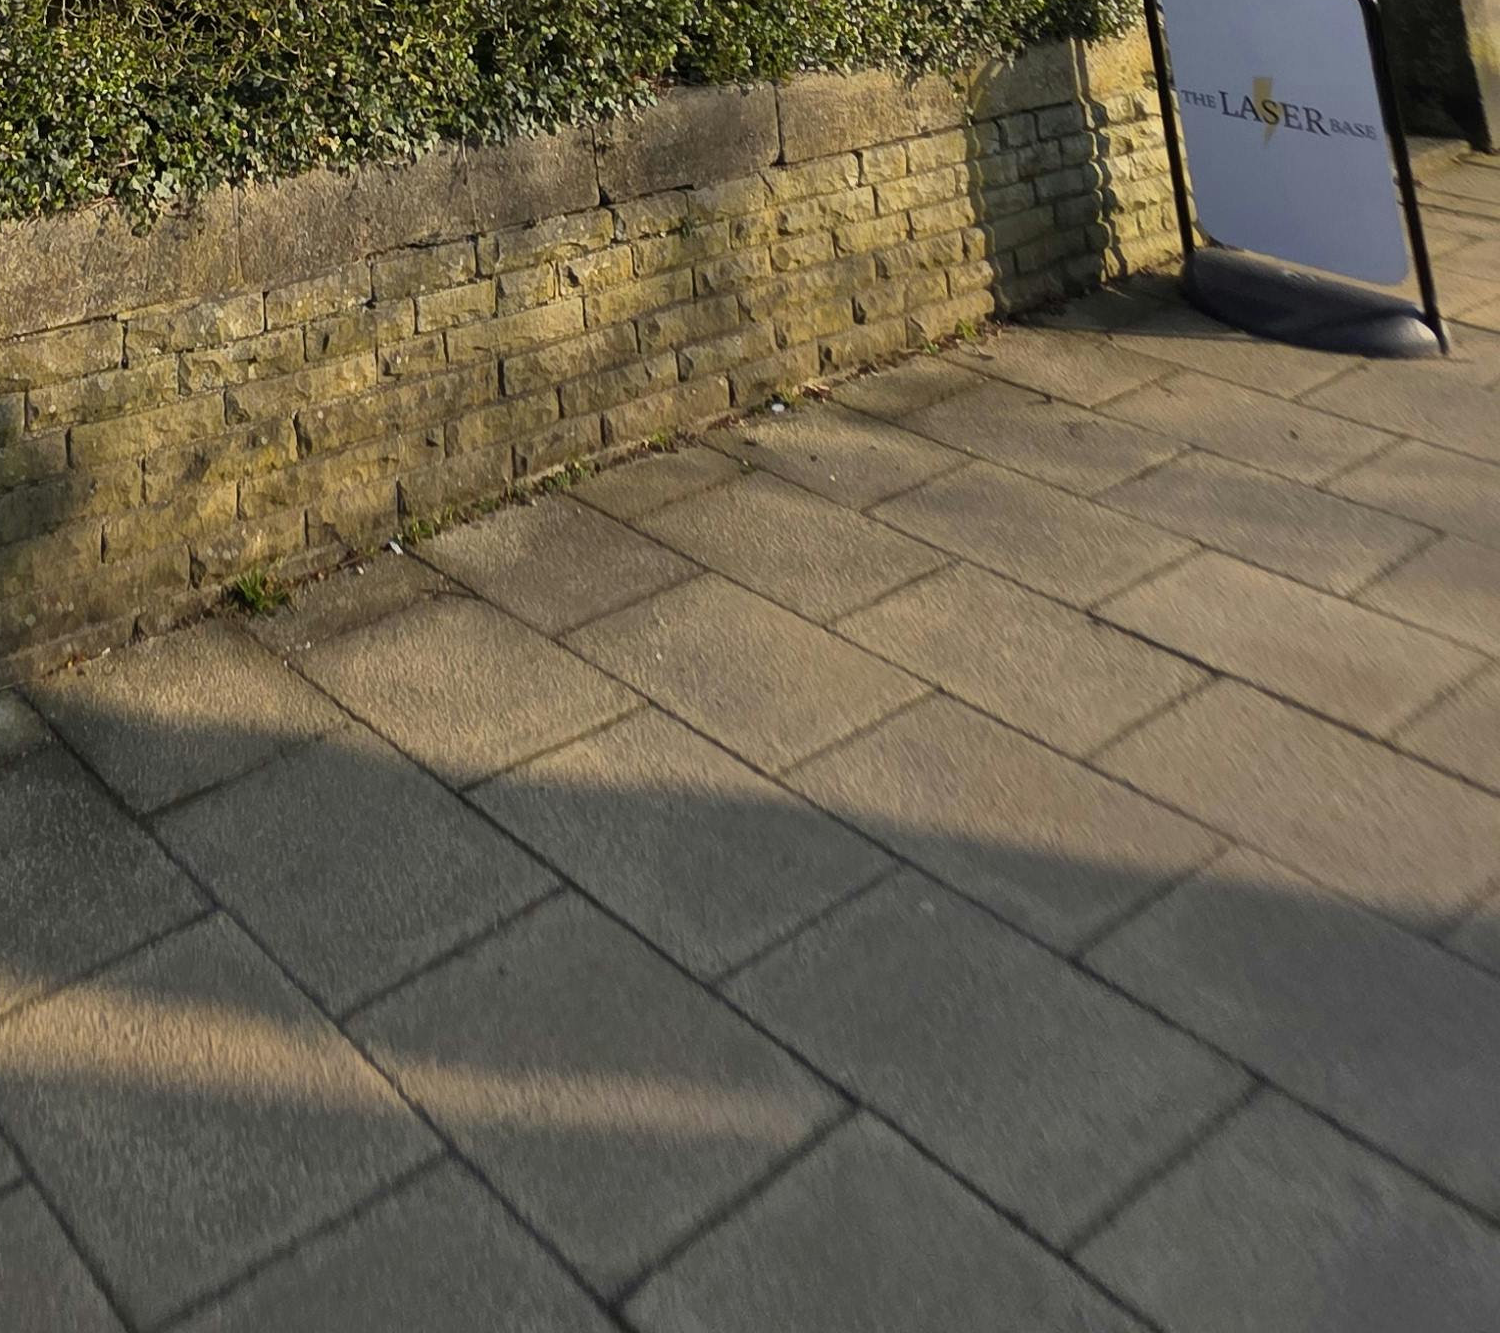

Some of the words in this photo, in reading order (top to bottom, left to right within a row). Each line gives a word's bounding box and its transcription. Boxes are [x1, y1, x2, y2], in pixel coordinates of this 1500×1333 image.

[1181, 89, 1216, 109] THE
[1218, 91, 1330, 136] LASER
[1329, 119, 1377, 140] BASE
